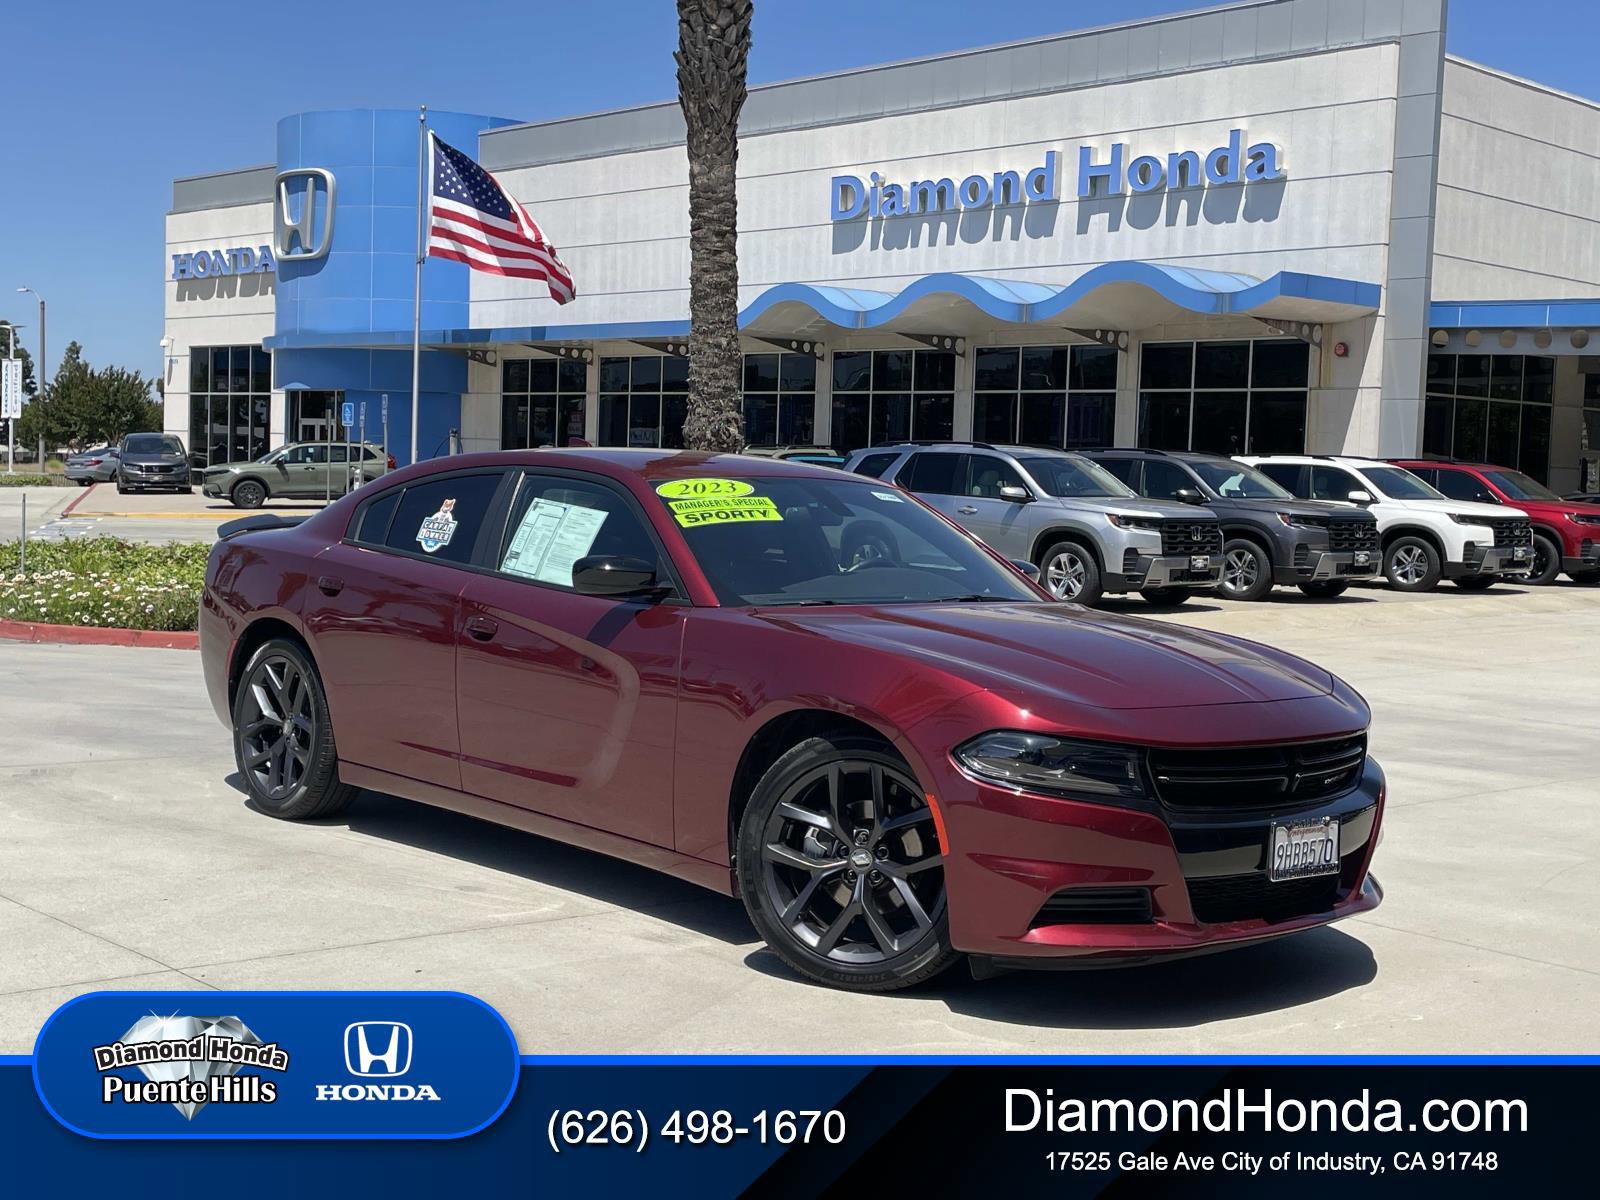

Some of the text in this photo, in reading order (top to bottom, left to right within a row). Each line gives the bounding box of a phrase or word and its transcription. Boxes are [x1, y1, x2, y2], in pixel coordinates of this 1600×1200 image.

[831, 129, 1281, 221] Diamond Honda
[172, 245, 276, 280] HONDA
[679, 483, 737, 495] 2023
[675, 498, 769, 511] MANAGER'S SPECIAL
[684, 510, 769, 523] SPORTY
[1275, 838, 1334, 869] 9HBB570
